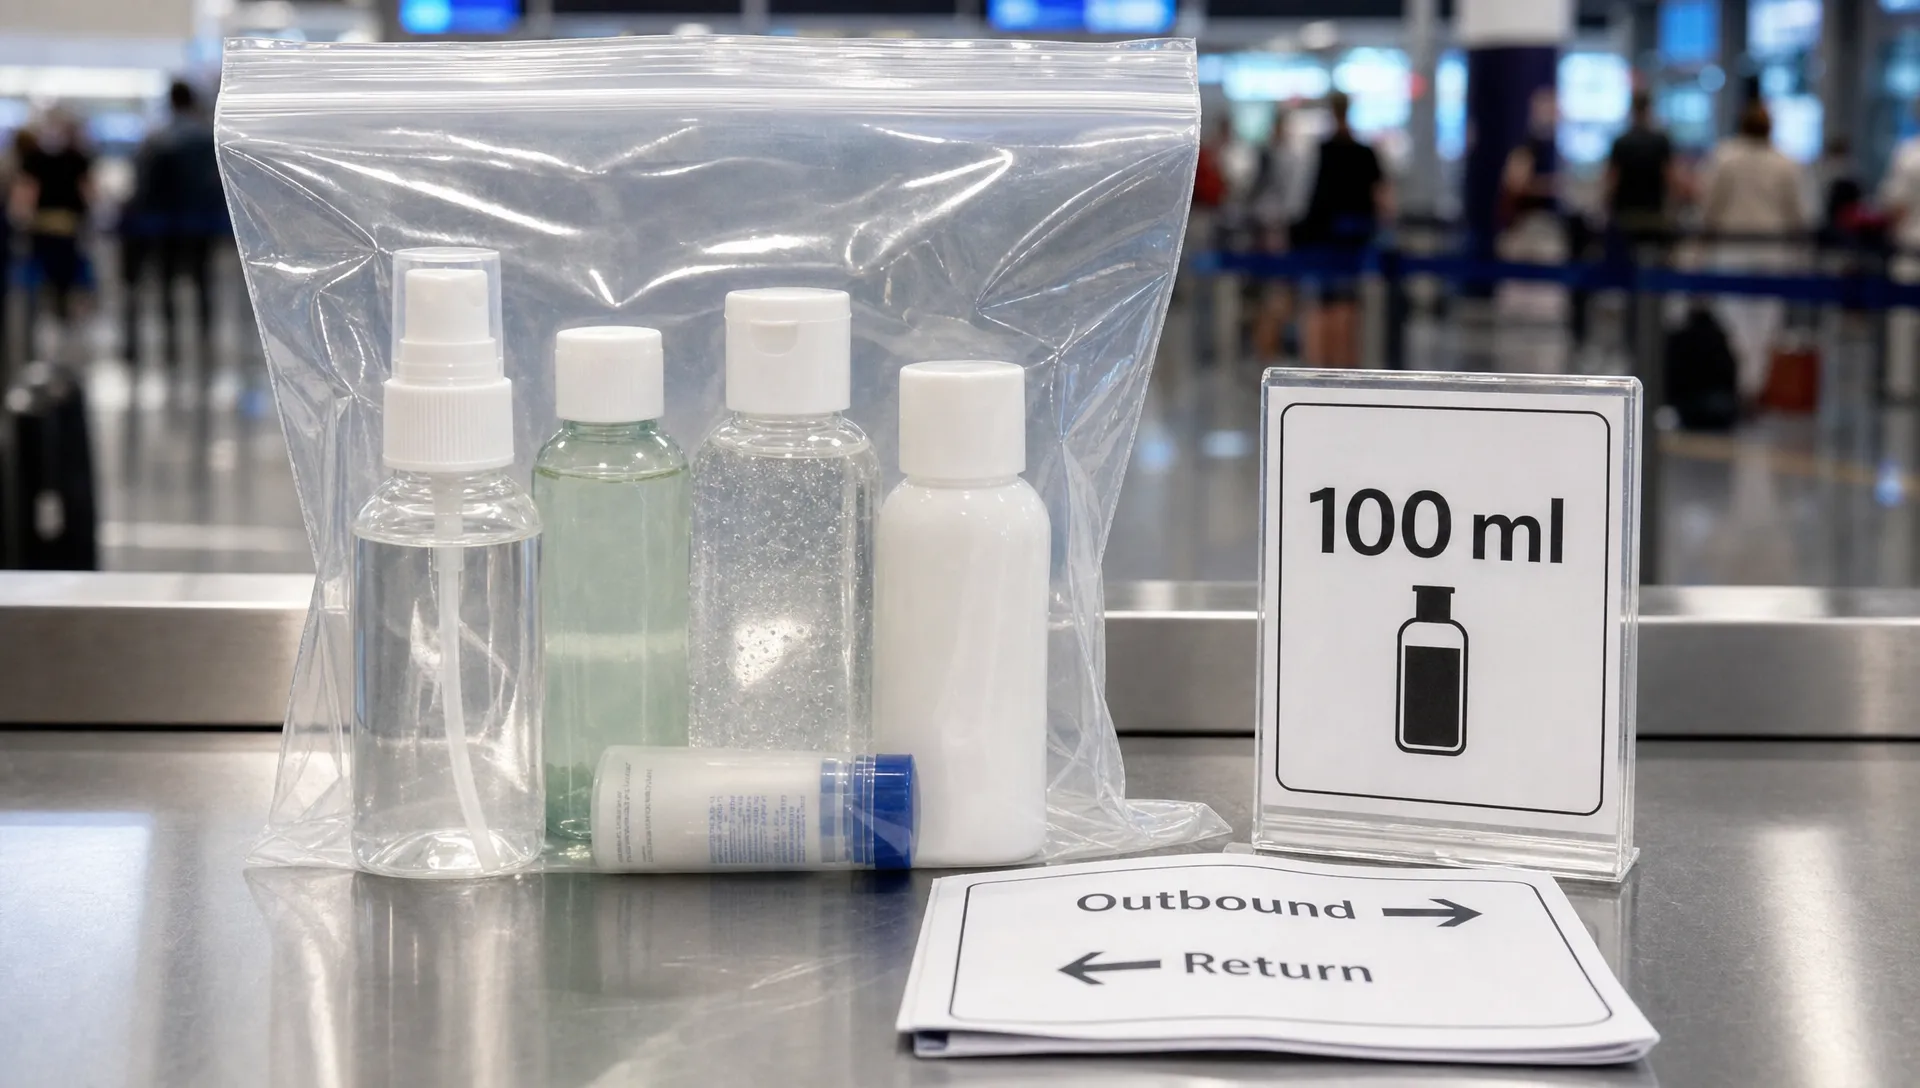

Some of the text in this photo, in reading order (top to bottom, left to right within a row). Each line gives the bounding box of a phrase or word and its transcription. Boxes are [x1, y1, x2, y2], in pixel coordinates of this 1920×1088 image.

[1309, 486, 1564, 564] 100 ml
[1077, 889, 1356, 920] Outbound
[1184, 952, 1373, 982] Return
